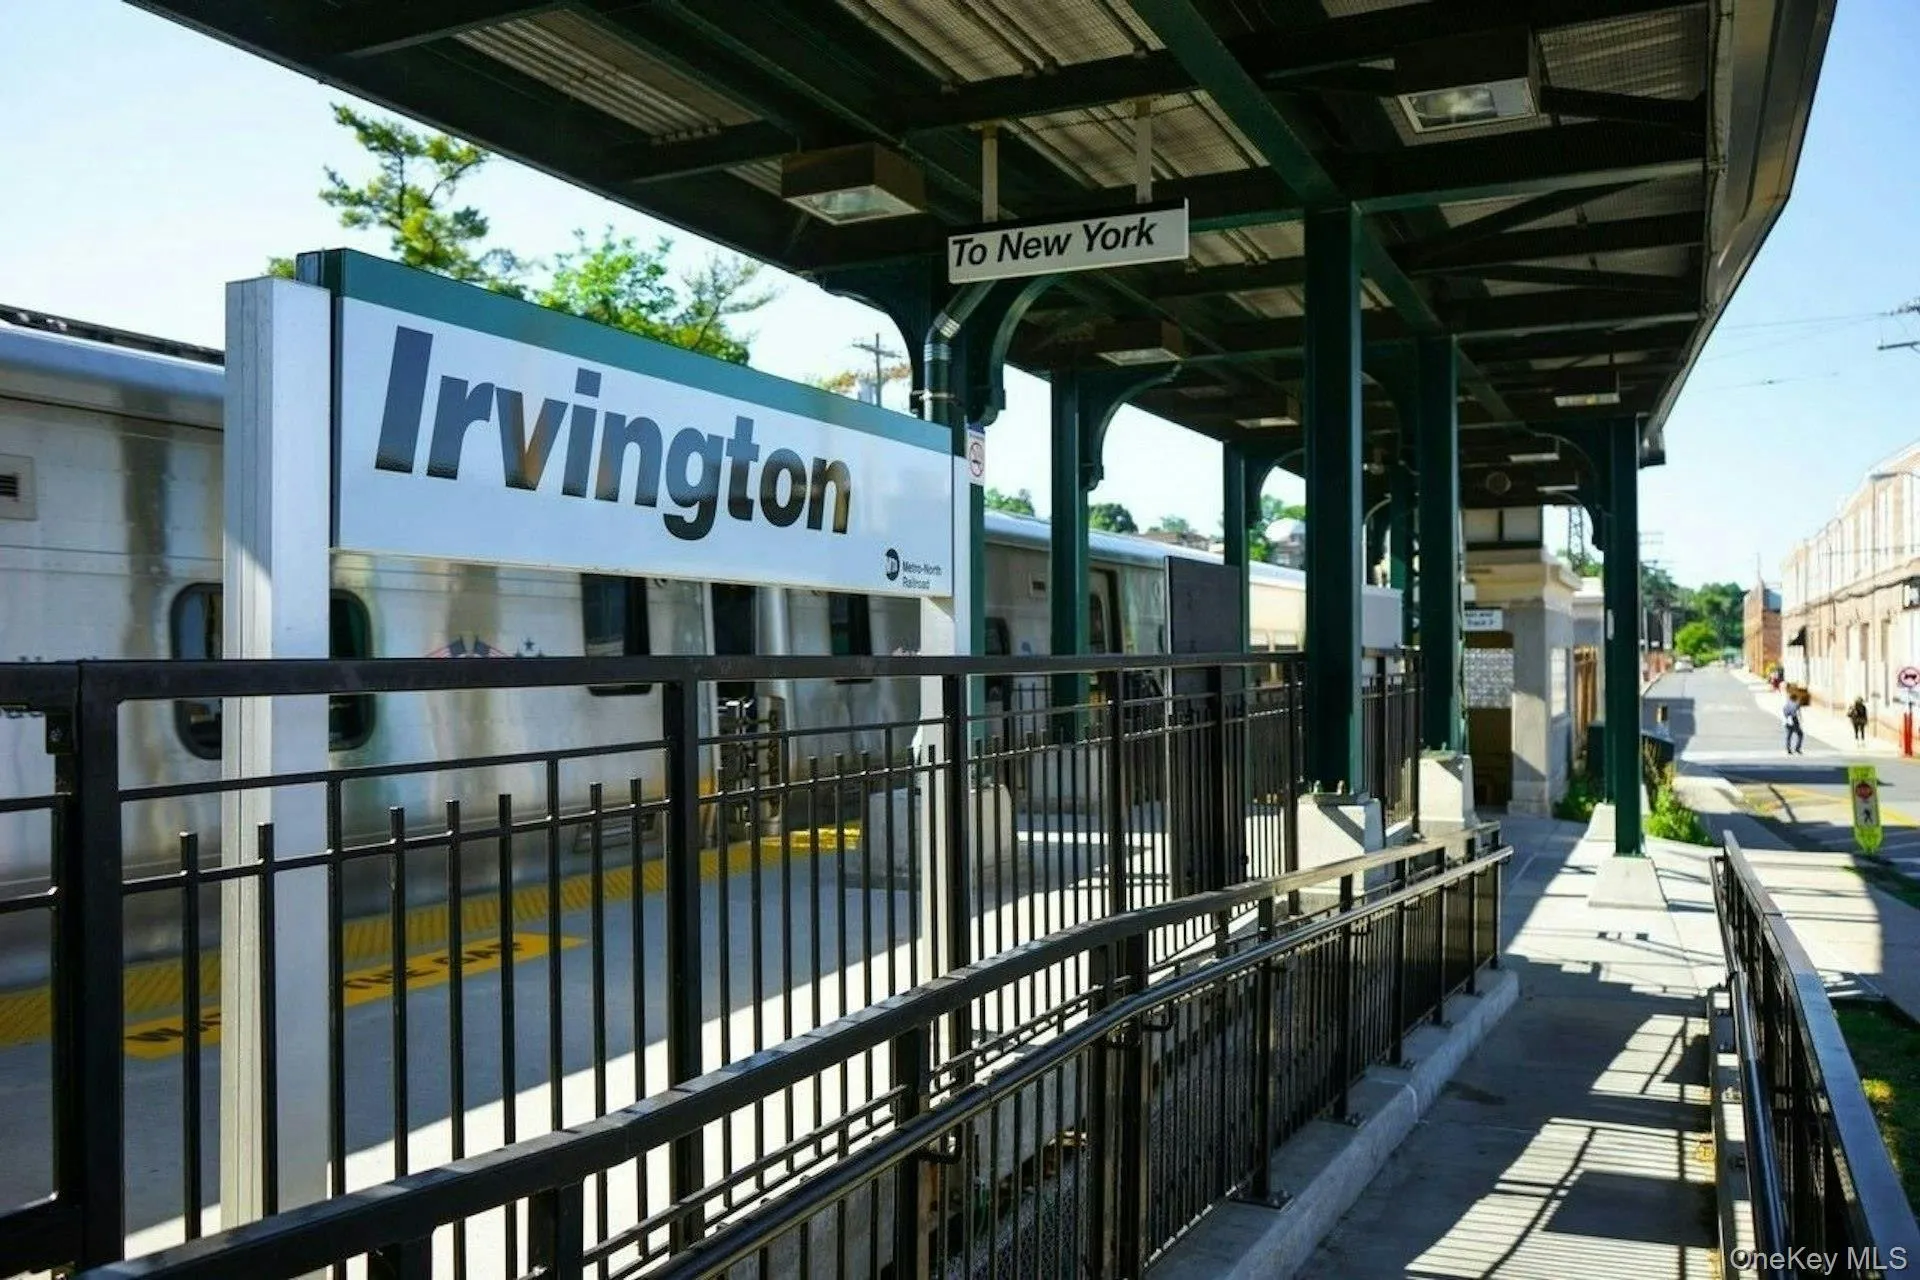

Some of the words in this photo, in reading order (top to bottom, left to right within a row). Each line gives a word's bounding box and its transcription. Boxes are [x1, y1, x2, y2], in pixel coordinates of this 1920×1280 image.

[952, 236, 987, 267] To
[997, 231, 1072, 263] New
[1082, 216, 1158, 252] York
[375, 326, 851, 541] Irvington
[902, 560, 942, 576] Metro-North
[902, 576, 930, 590] Railroad
